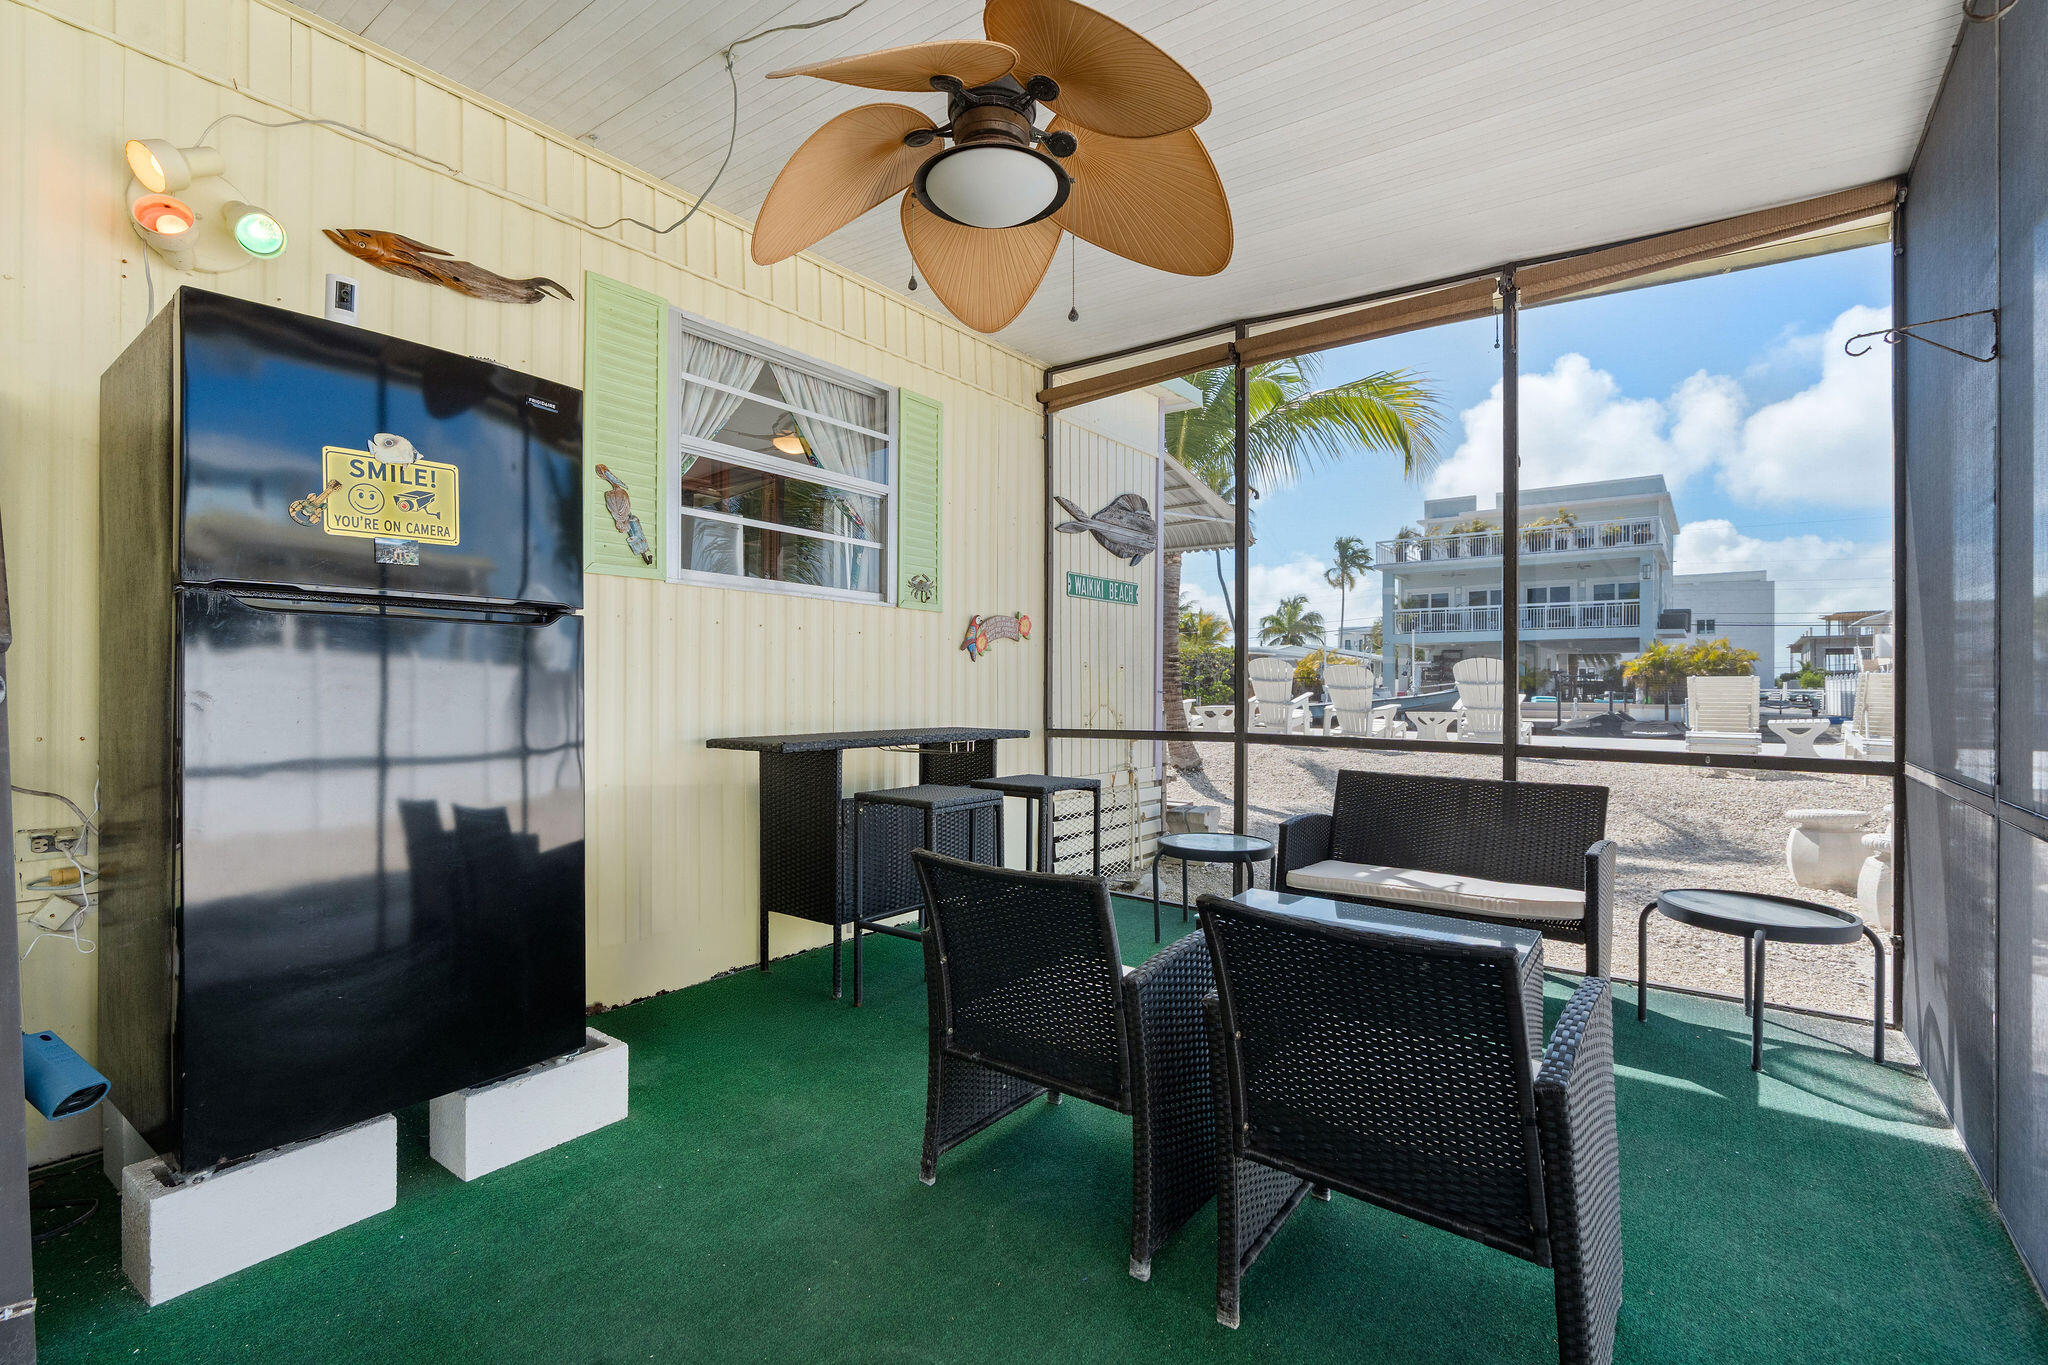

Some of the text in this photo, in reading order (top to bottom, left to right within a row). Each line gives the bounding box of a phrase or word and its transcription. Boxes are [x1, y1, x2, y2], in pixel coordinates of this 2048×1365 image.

[349, 459, 436, 489] SMILE!
[334, 514, 451, 538] YOU'RE ON CAMERA
[1074, 576, 1134, 603] WAIKIKI BEACH
